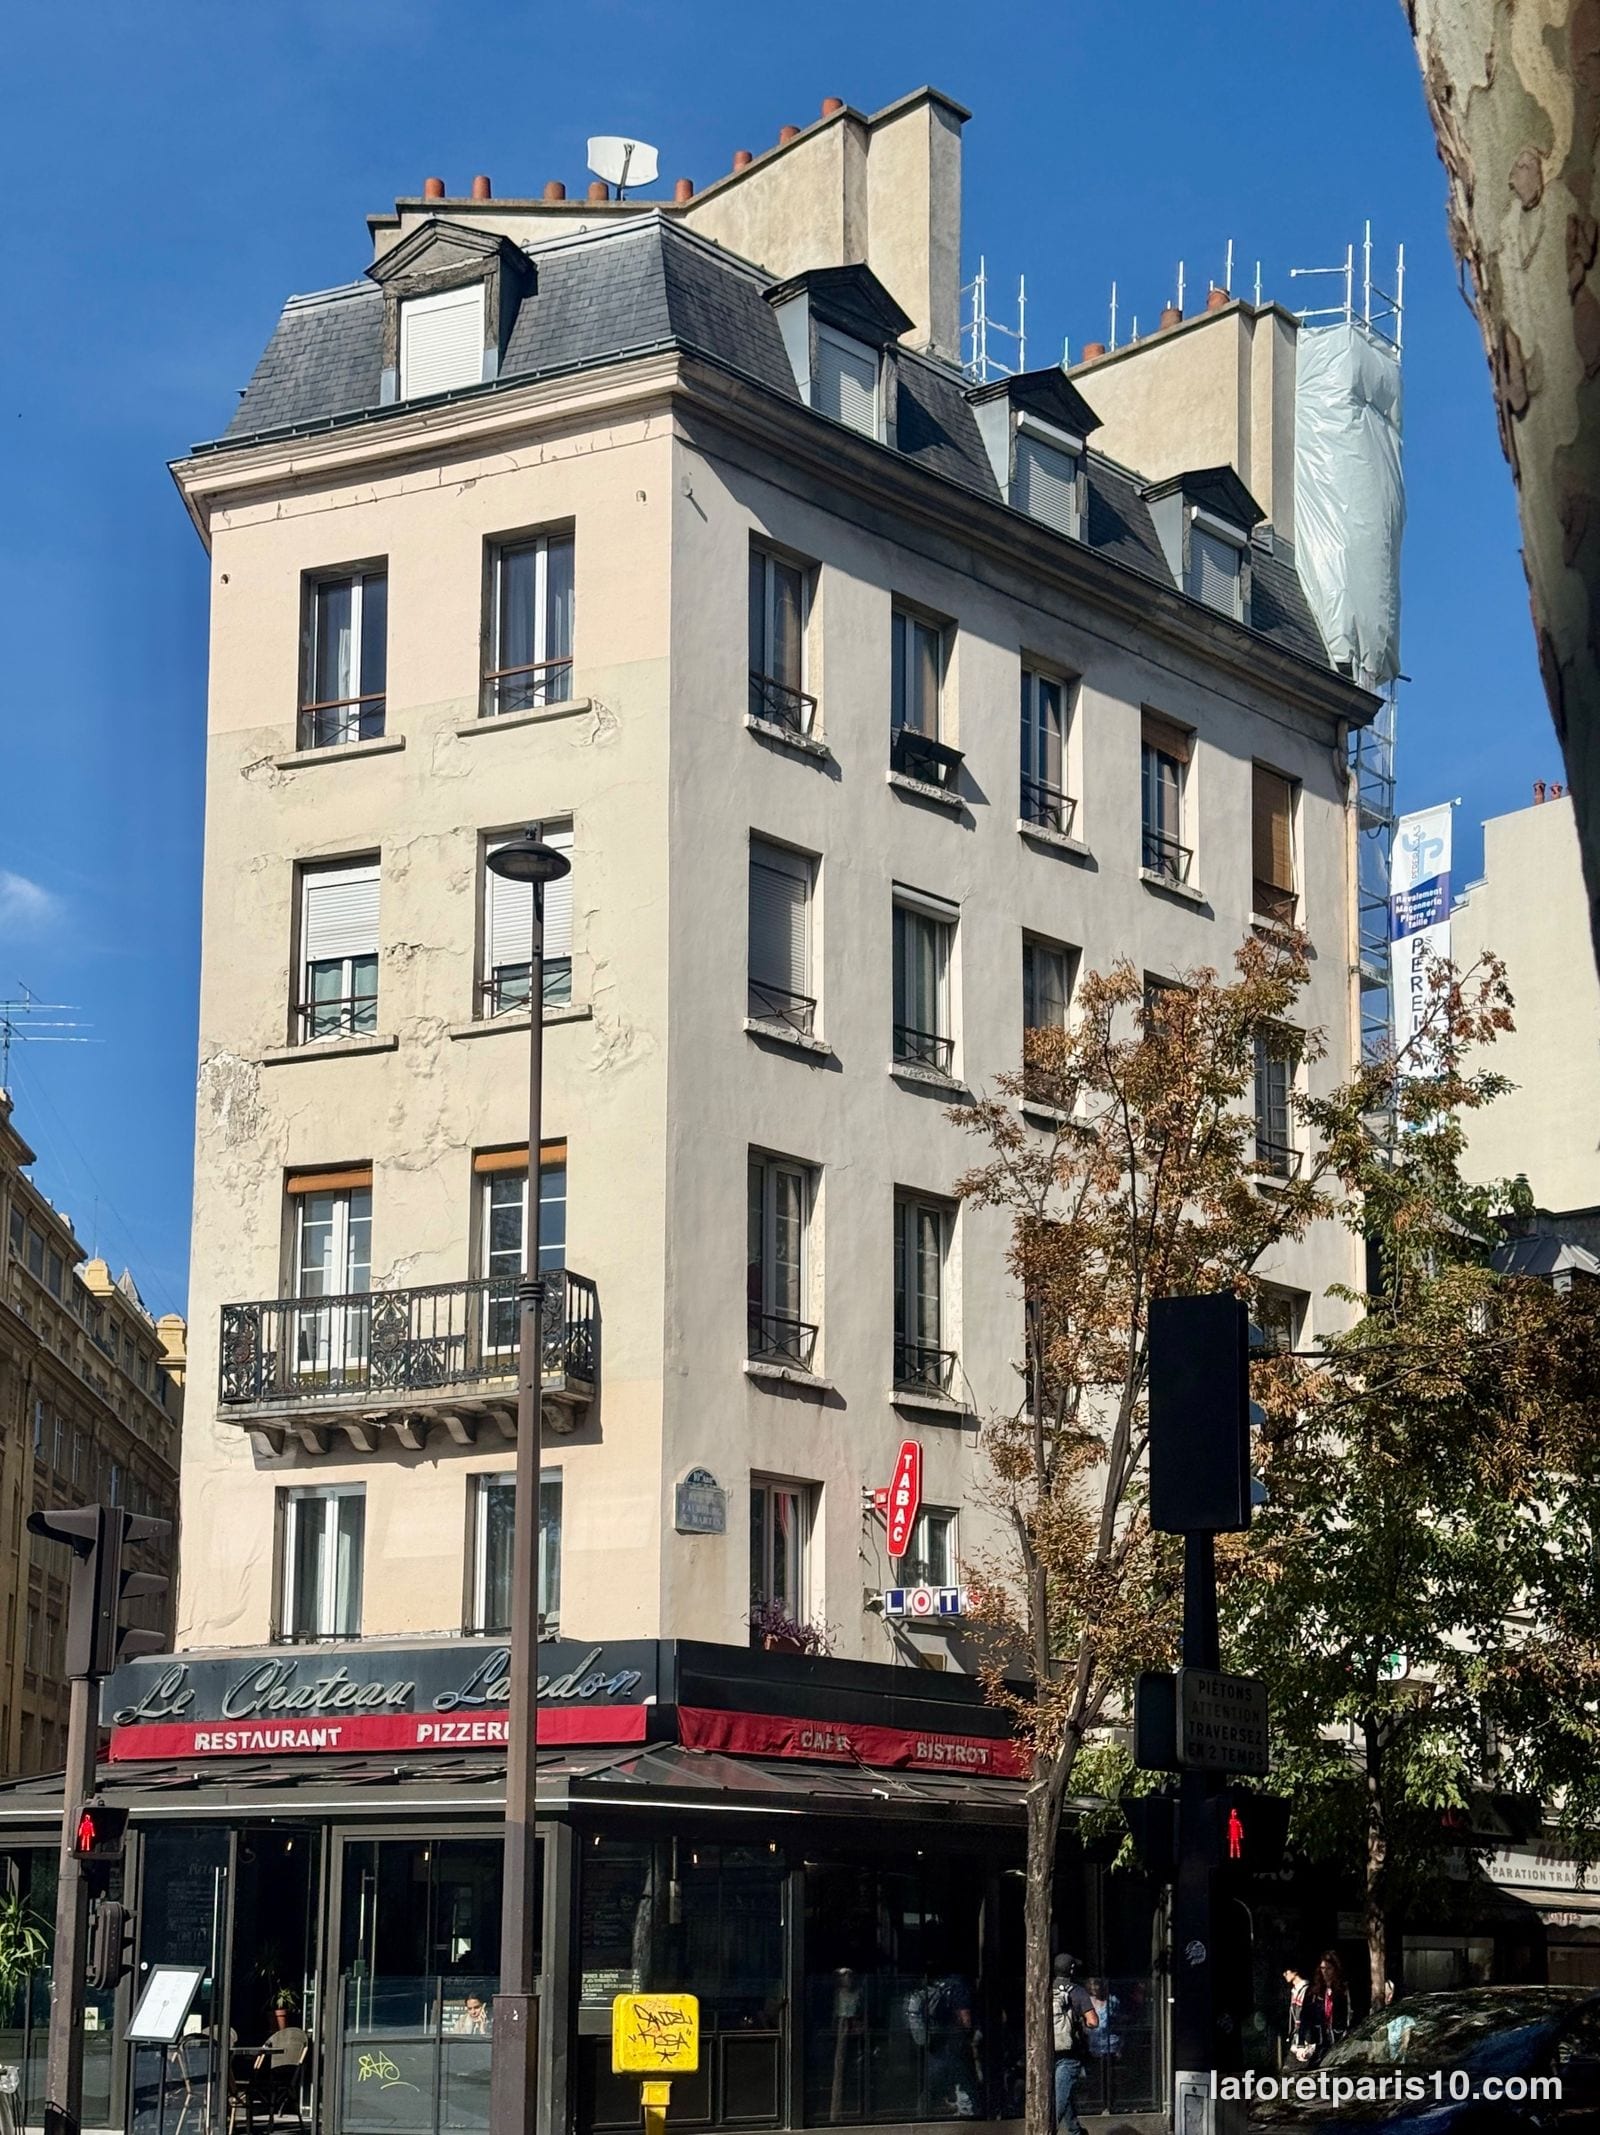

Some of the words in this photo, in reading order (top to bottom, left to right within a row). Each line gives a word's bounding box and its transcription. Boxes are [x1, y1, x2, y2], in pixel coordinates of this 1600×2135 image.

[1400, 912, 1425, 923] Pierre
[892, 1453, 914, 1543] TABAC
[112, 1662, 196, 1725] Le
[222, 1658, 416, 1720] Chateau
[1198, 1678, 1252, 1702] PIÉTONS
[1191, 1701, 1260, 1723] ATTENTION
[194, 1726, 343, 1751] RESTAURANT
[416, 1721, 509, 1744] PIZZERI
[1189, 1721, 1262, 1746] TRAVERSEZ
[917, 1742, 989, 1765] BISTROT
[1188, 1742, 1203, 1757] EN
[1208, 1745, 1217, 1760] 2
[1221, 1747, 1264, 1766] TEMPS
